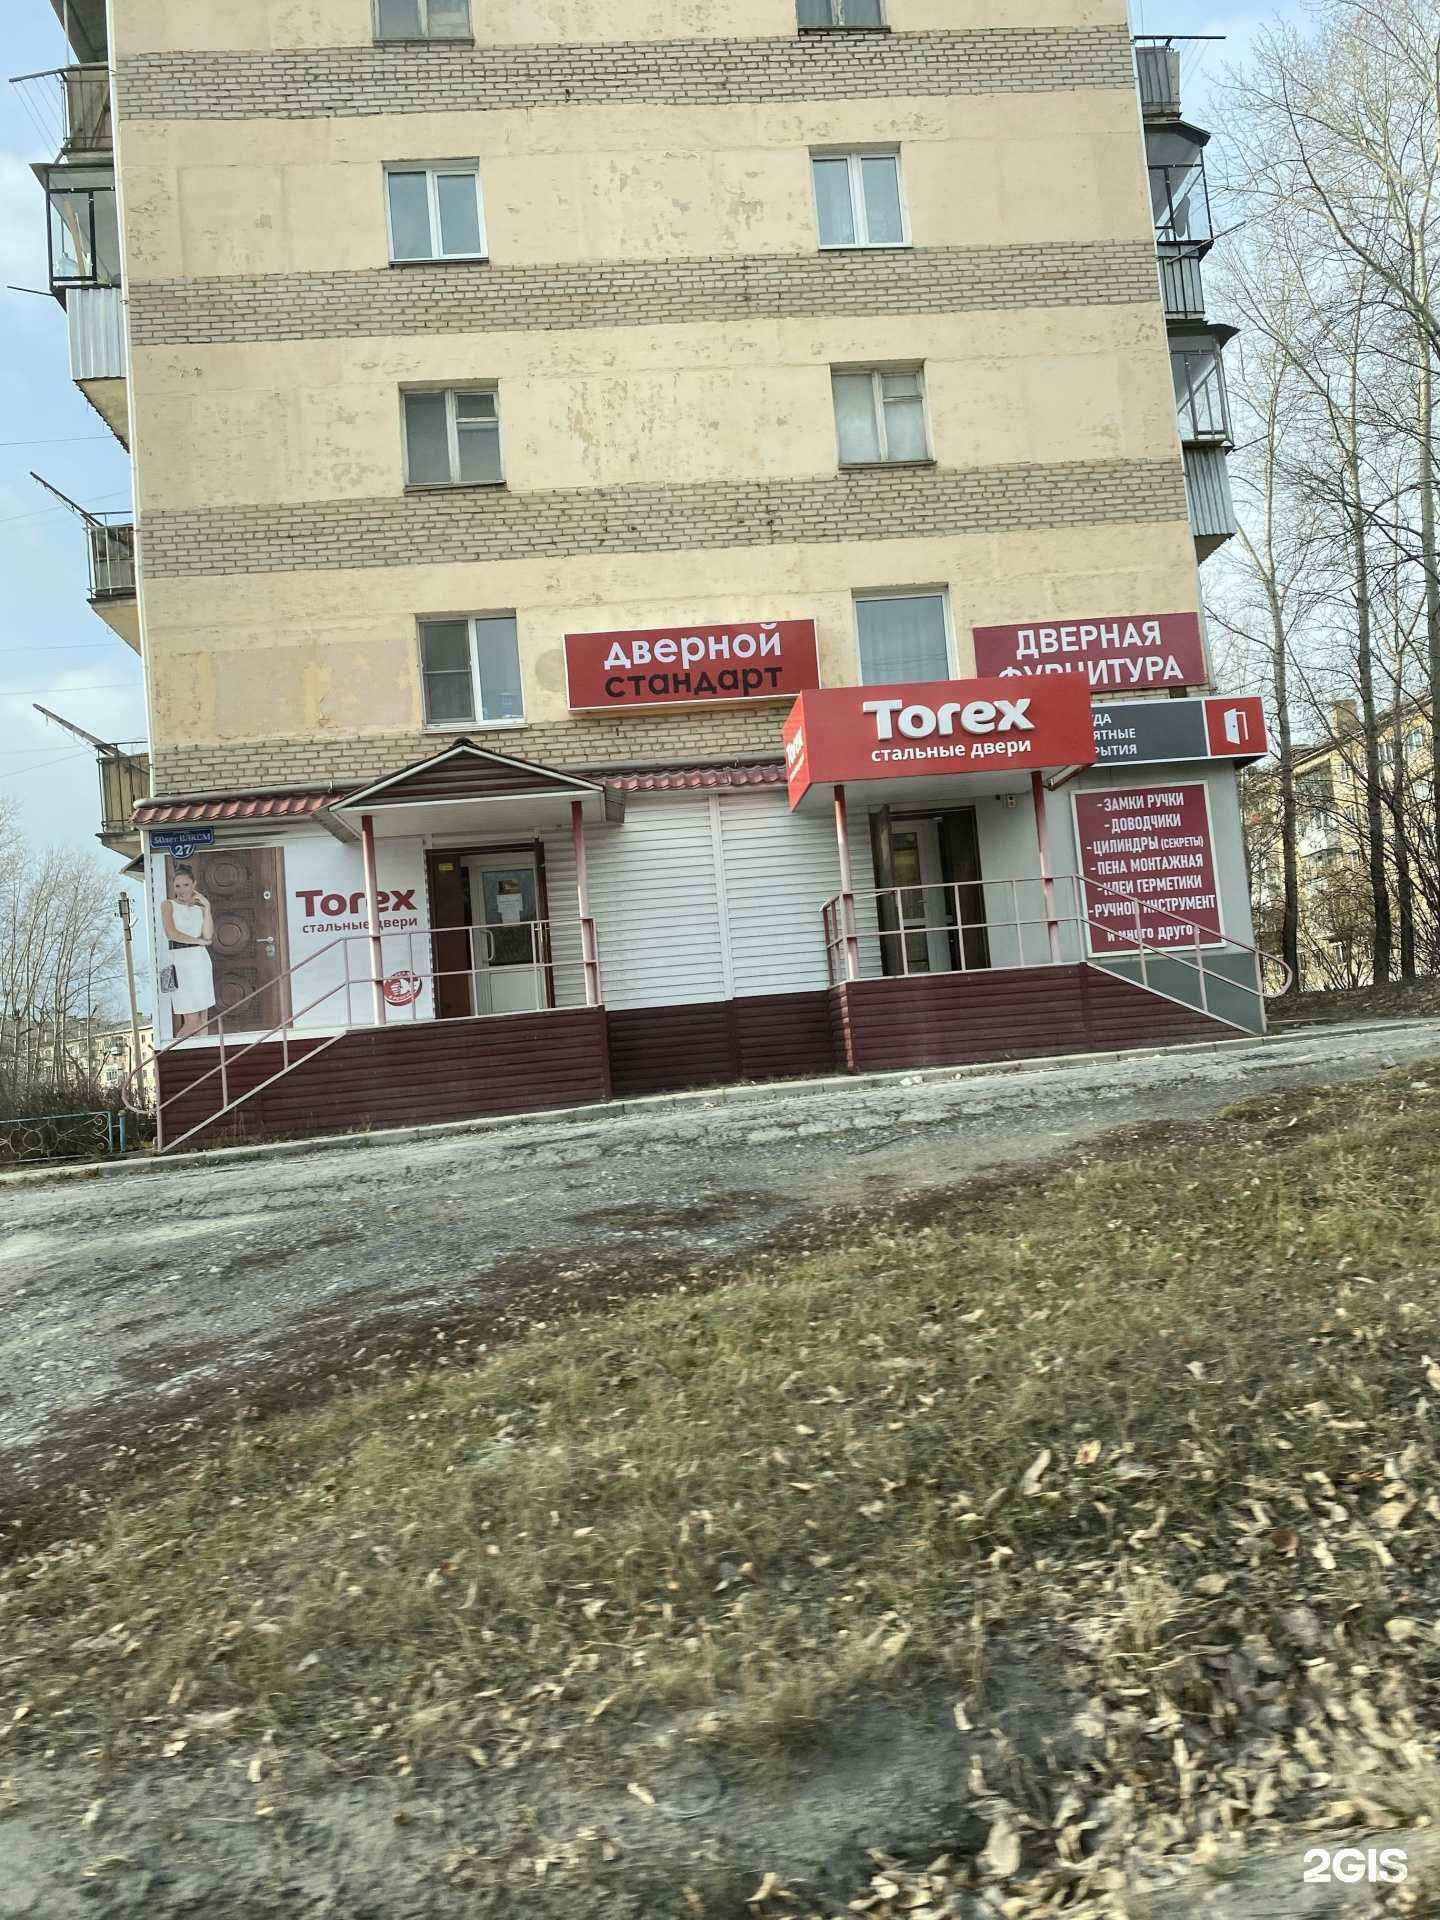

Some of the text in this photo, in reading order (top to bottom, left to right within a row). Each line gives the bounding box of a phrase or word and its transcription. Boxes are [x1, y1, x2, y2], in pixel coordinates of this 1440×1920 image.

[1016, 621, 1162, 660] ДВЕРНАЯ
[862, 698, 1036, 742] Torex
[1092, 713, 1112, 727] ДА
[871, 739, 1032, 762] стальные двери
[1147, 792, 1184, 808] РУЧКИ
[174, 844, 192, 856] 27
[1131, 853, 1204, 873] МОНТАЖНАЯ
[1136, 875, 1203, 893] ГЕРМЕТИКИ
[295, 889, 418, 917] Torex
[302, 920, 369, 934] стальные
[1158, 924, 1201, 941] друго
